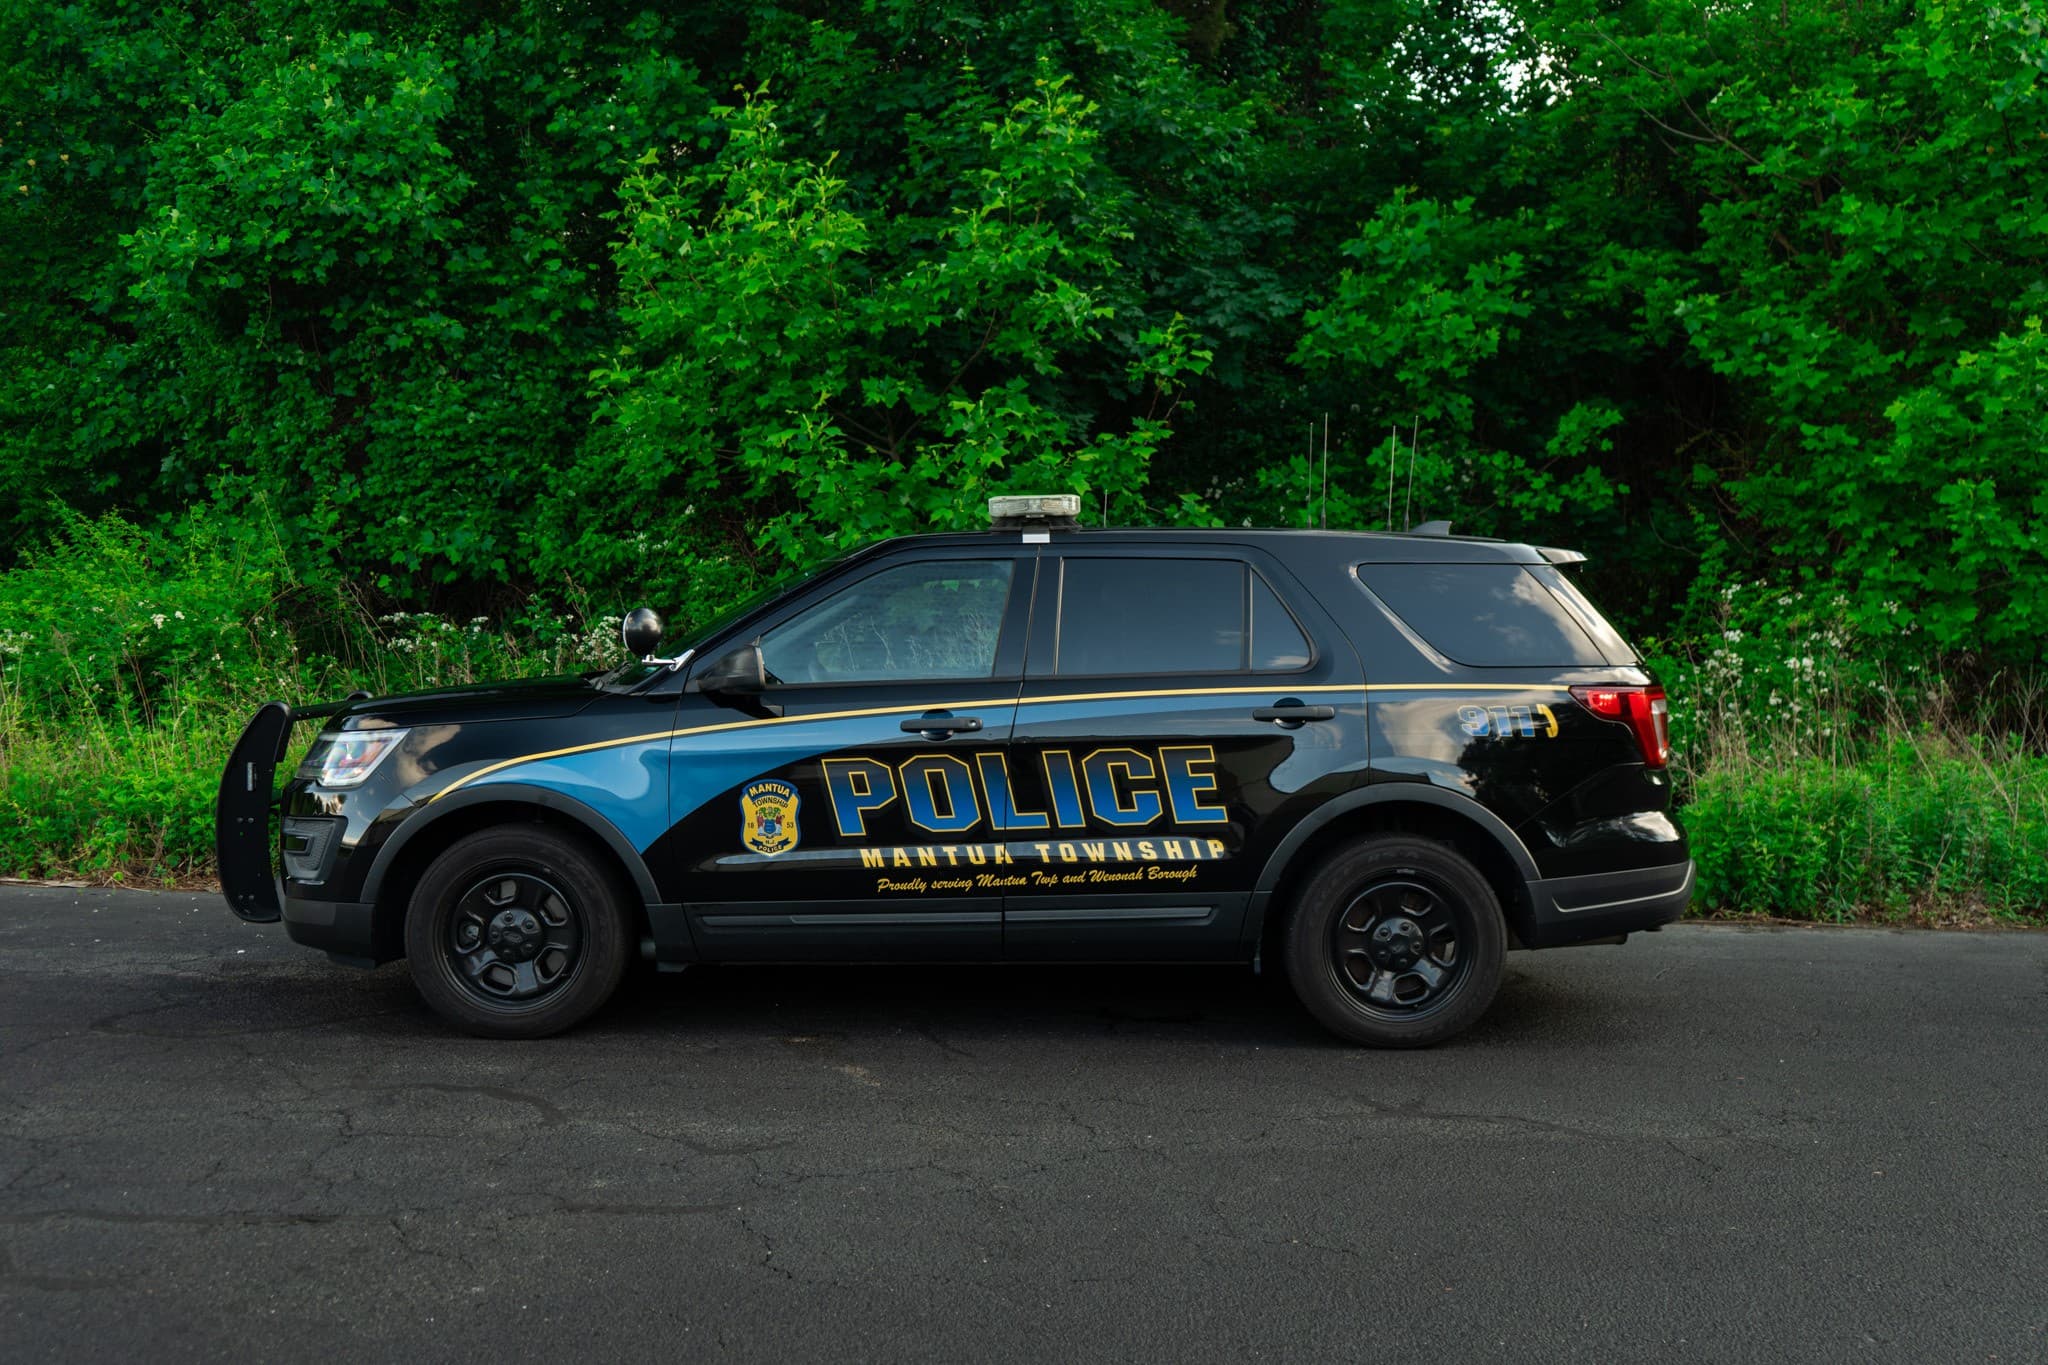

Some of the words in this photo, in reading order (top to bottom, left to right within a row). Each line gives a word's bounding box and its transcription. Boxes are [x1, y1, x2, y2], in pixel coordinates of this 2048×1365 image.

[1458, 705, 1535, 737] 911
[749, 784, 790, 797] MANTUA
[753, 797, 788, 808] TOWNSHIP
[821, 745, 1229, 836] POLICE
[758, 845, 782, 853] POLICE
[861, 844, 1014, 868] MANTUA
[1035, 839, 1226, 864] TOWNSHIP
[877, 877, 927, 893] Proudly
[931, 877, 973, 892] serving
[976, 873, 1027, 887] Mantua
[1031, 870, 1058, 886] Twp
[1063, 870, 1086, 884] and
[1089, 867, 1144, 883] Wenonah
[1148, 864, 1197, 883] Borough
